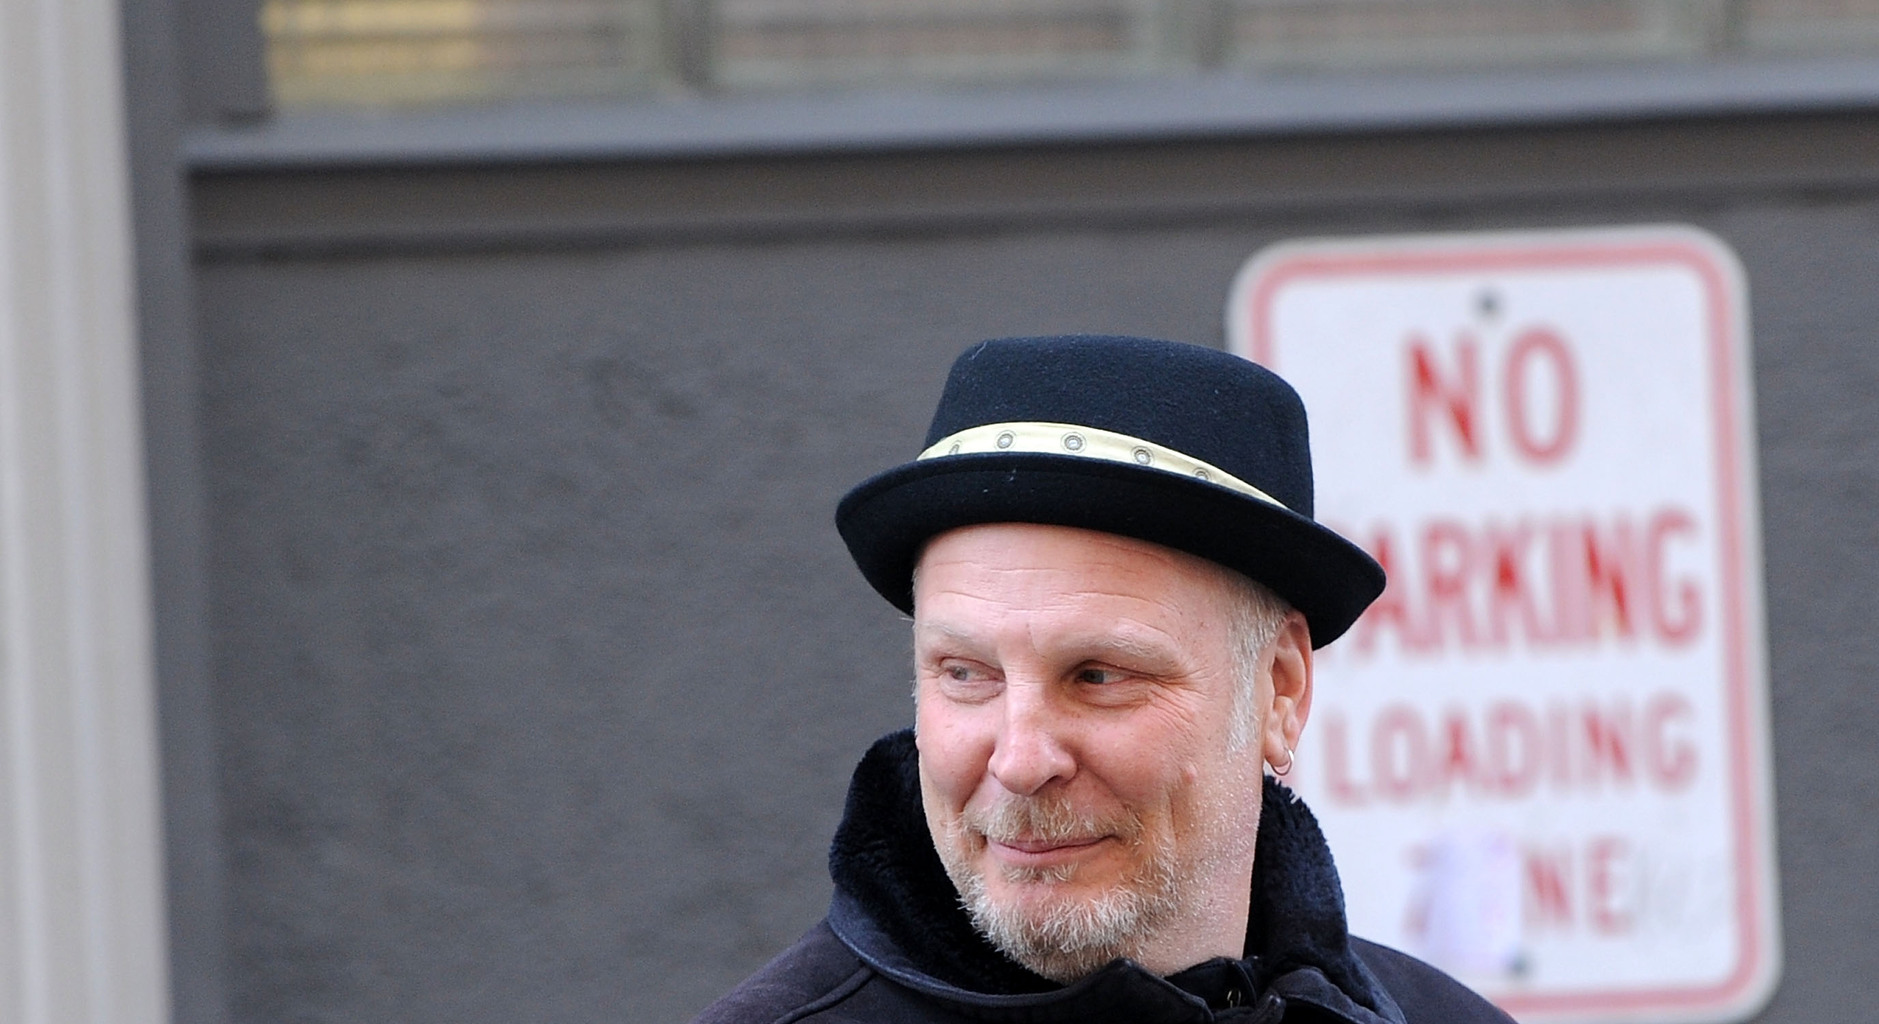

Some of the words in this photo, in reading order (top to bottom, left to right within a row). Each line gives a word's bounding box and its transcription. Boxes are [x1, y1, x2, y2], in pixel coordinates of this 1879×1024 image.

[1406, 326, 1581, 468] NO
[1314, 507, 1700, 656] ARKING
[1322, 688, 1699, 808] LOADING
[1402, 834, 1637, 943] ZNE
